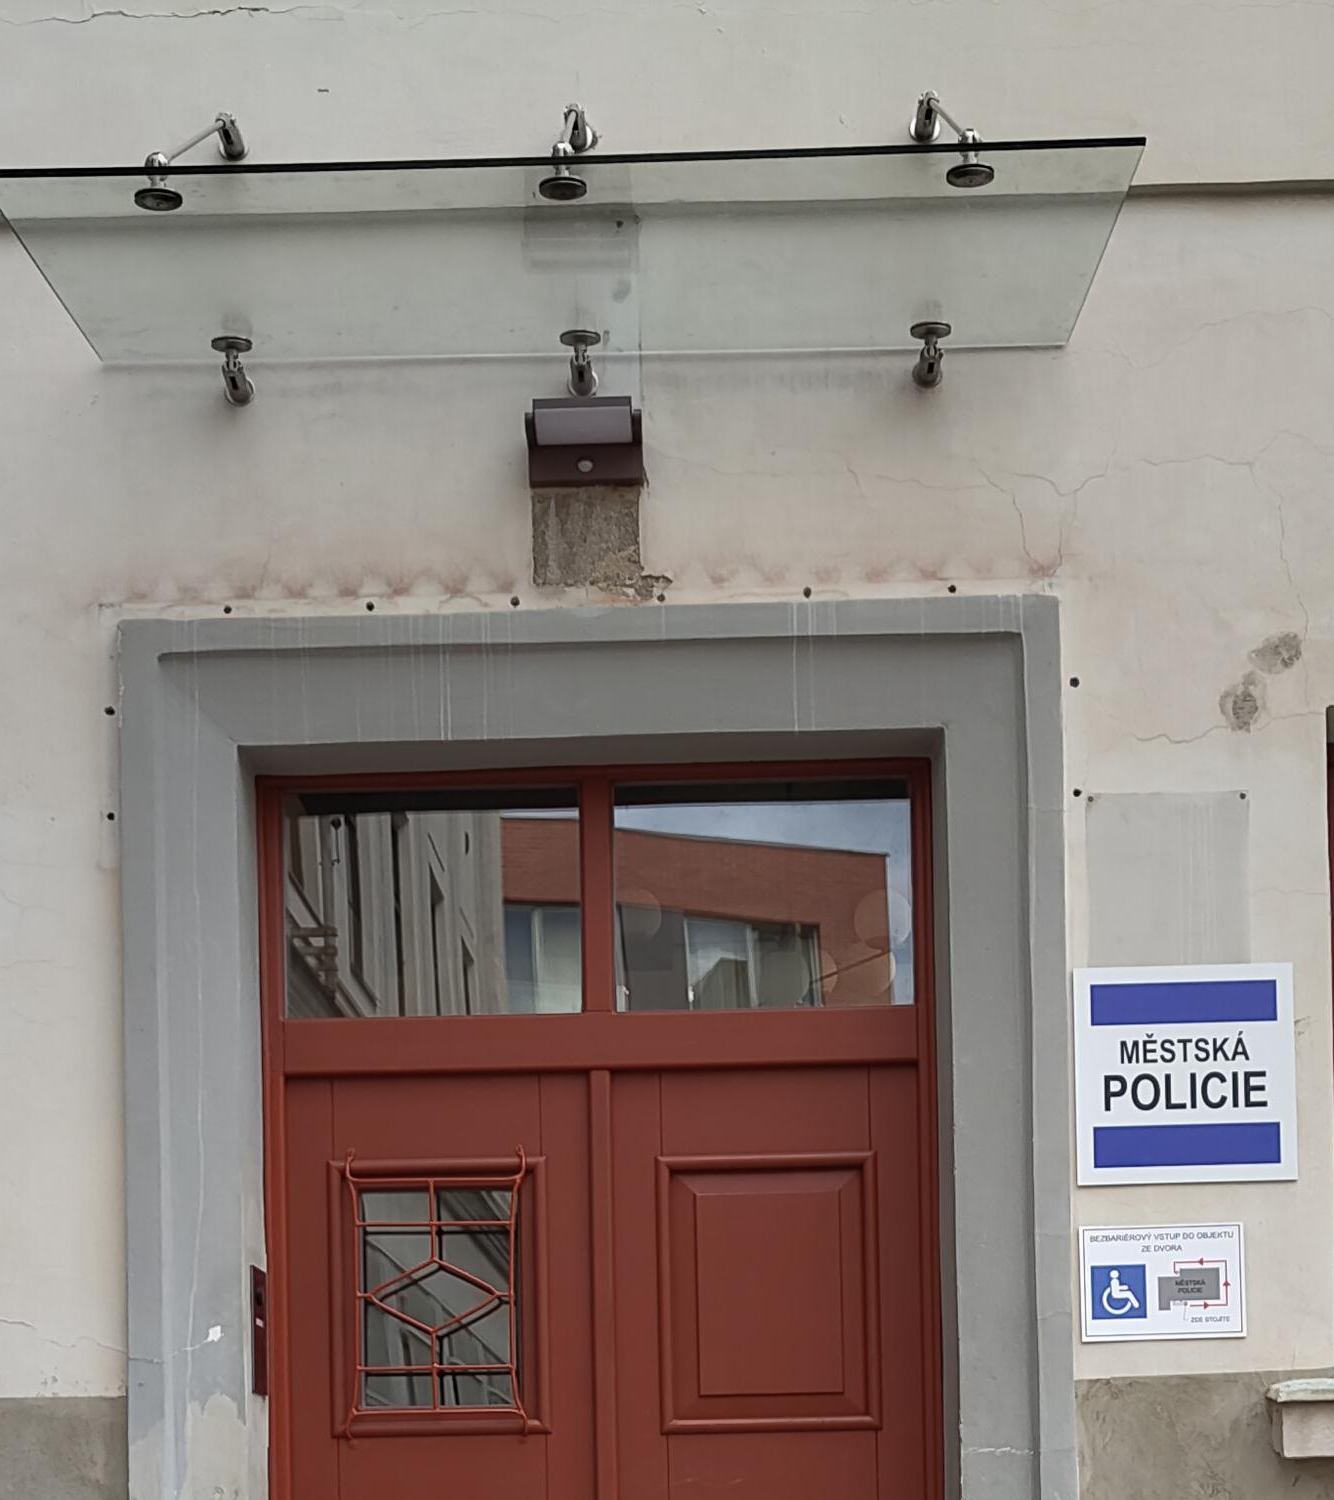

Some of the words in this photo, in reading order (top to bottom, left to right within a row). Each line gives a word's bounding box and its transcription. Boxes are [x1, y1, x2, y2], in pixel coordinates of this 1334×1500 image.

[1120, 1031, 1250, 1064] MĚSTSKÁ
[1104, 1070, 1268, 1111] POLICIE
[1089, 1231, 1151, 1242] BEZBARIÉROVÝ
[1154, 1231, 1180, 1241] VSTUP
[1182, 1231, 1194, 1240] DO
[1196, 1230, 1233, 1239] OBJEKTU
[1154, 1244, 1182, 1252] DVORA
